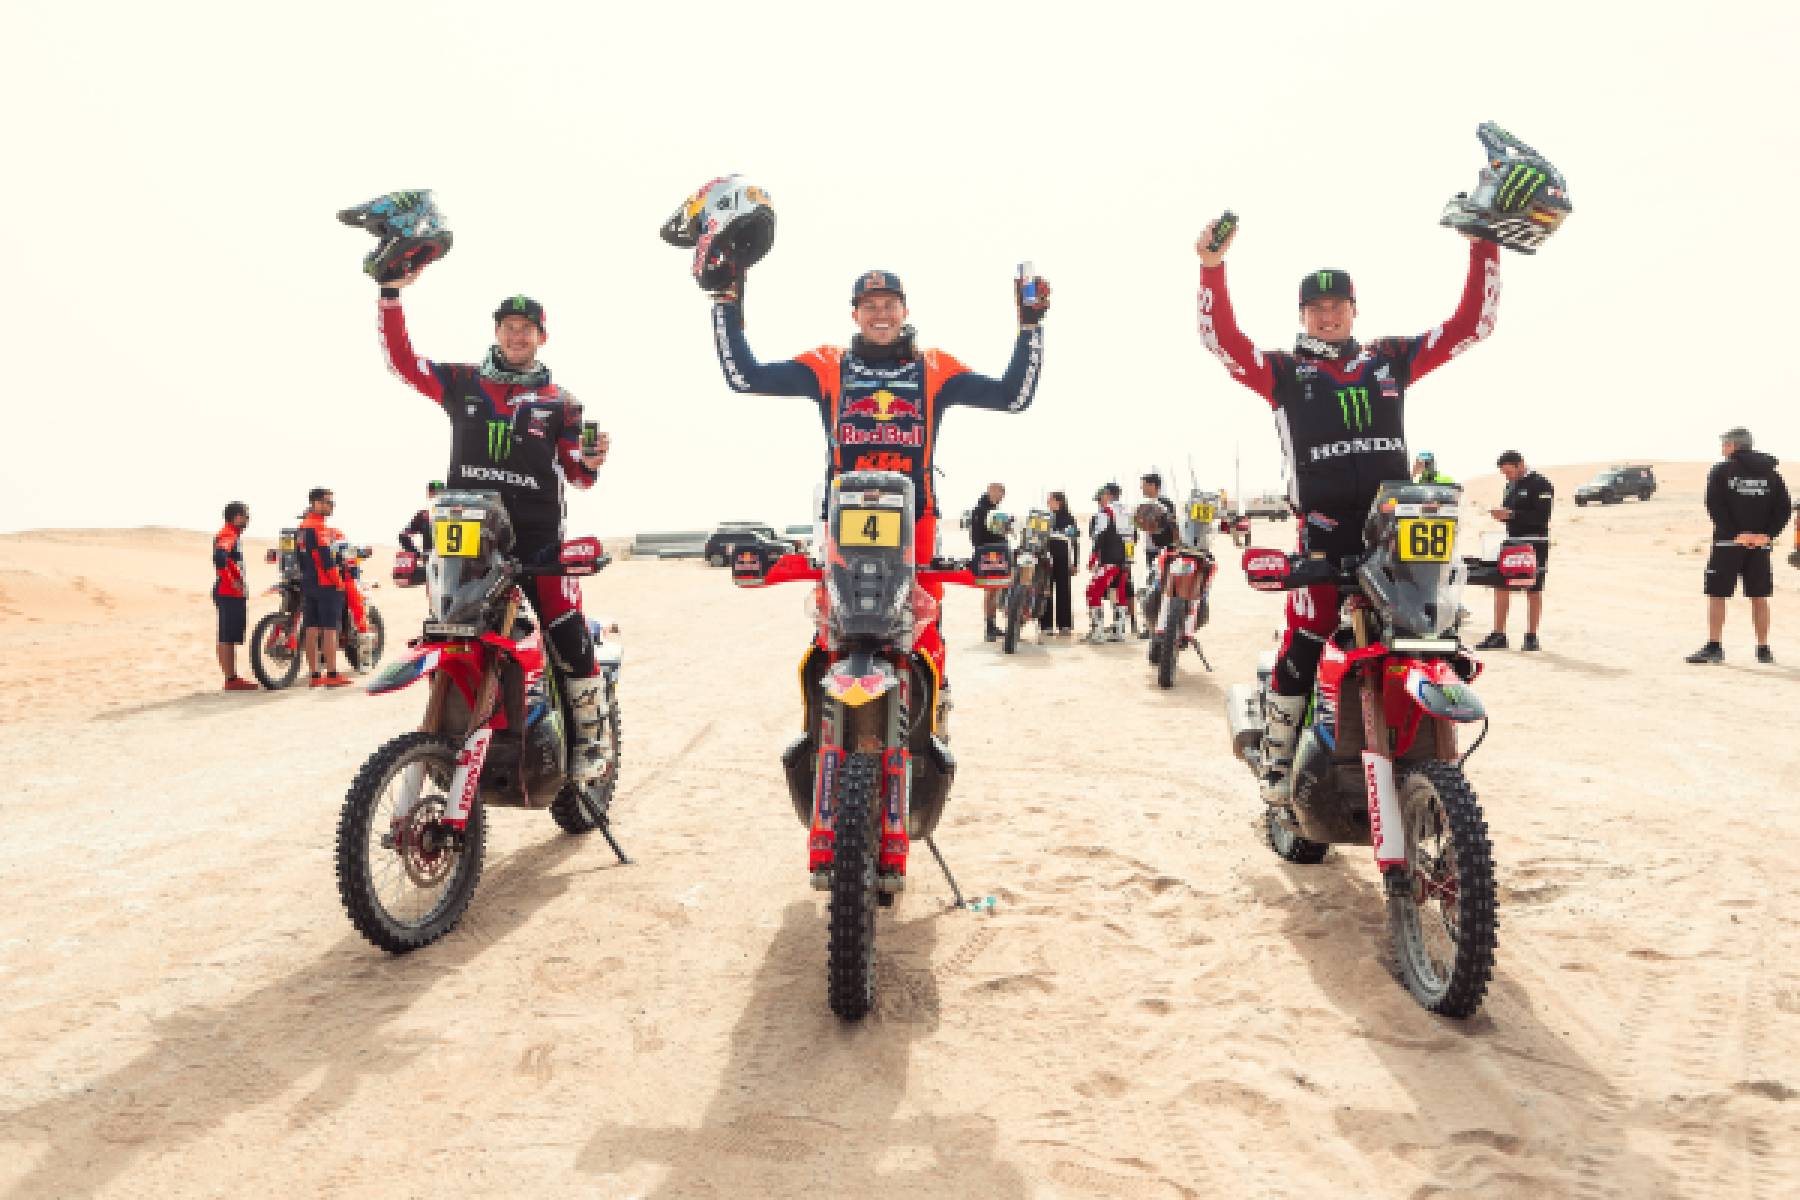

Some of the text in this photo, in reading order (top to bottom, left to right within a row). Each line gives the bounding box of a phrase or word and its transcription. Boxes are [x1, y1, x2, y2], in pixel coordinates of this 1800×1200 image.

[841, 423, 923, 445] Red Bull
[855, 451, 912, 471] KTM
[1311, 438, 1405, 462] HONDA
[461, 464, 541, 489] HONDA
[447, 524, 463, 553] 9
[862, 514, 880, 543] 4
[1409, 523, 1448, 557] 68
[459, 738, 487, 811] HONDA
[1366, 761, 1384, 849] HONDA
